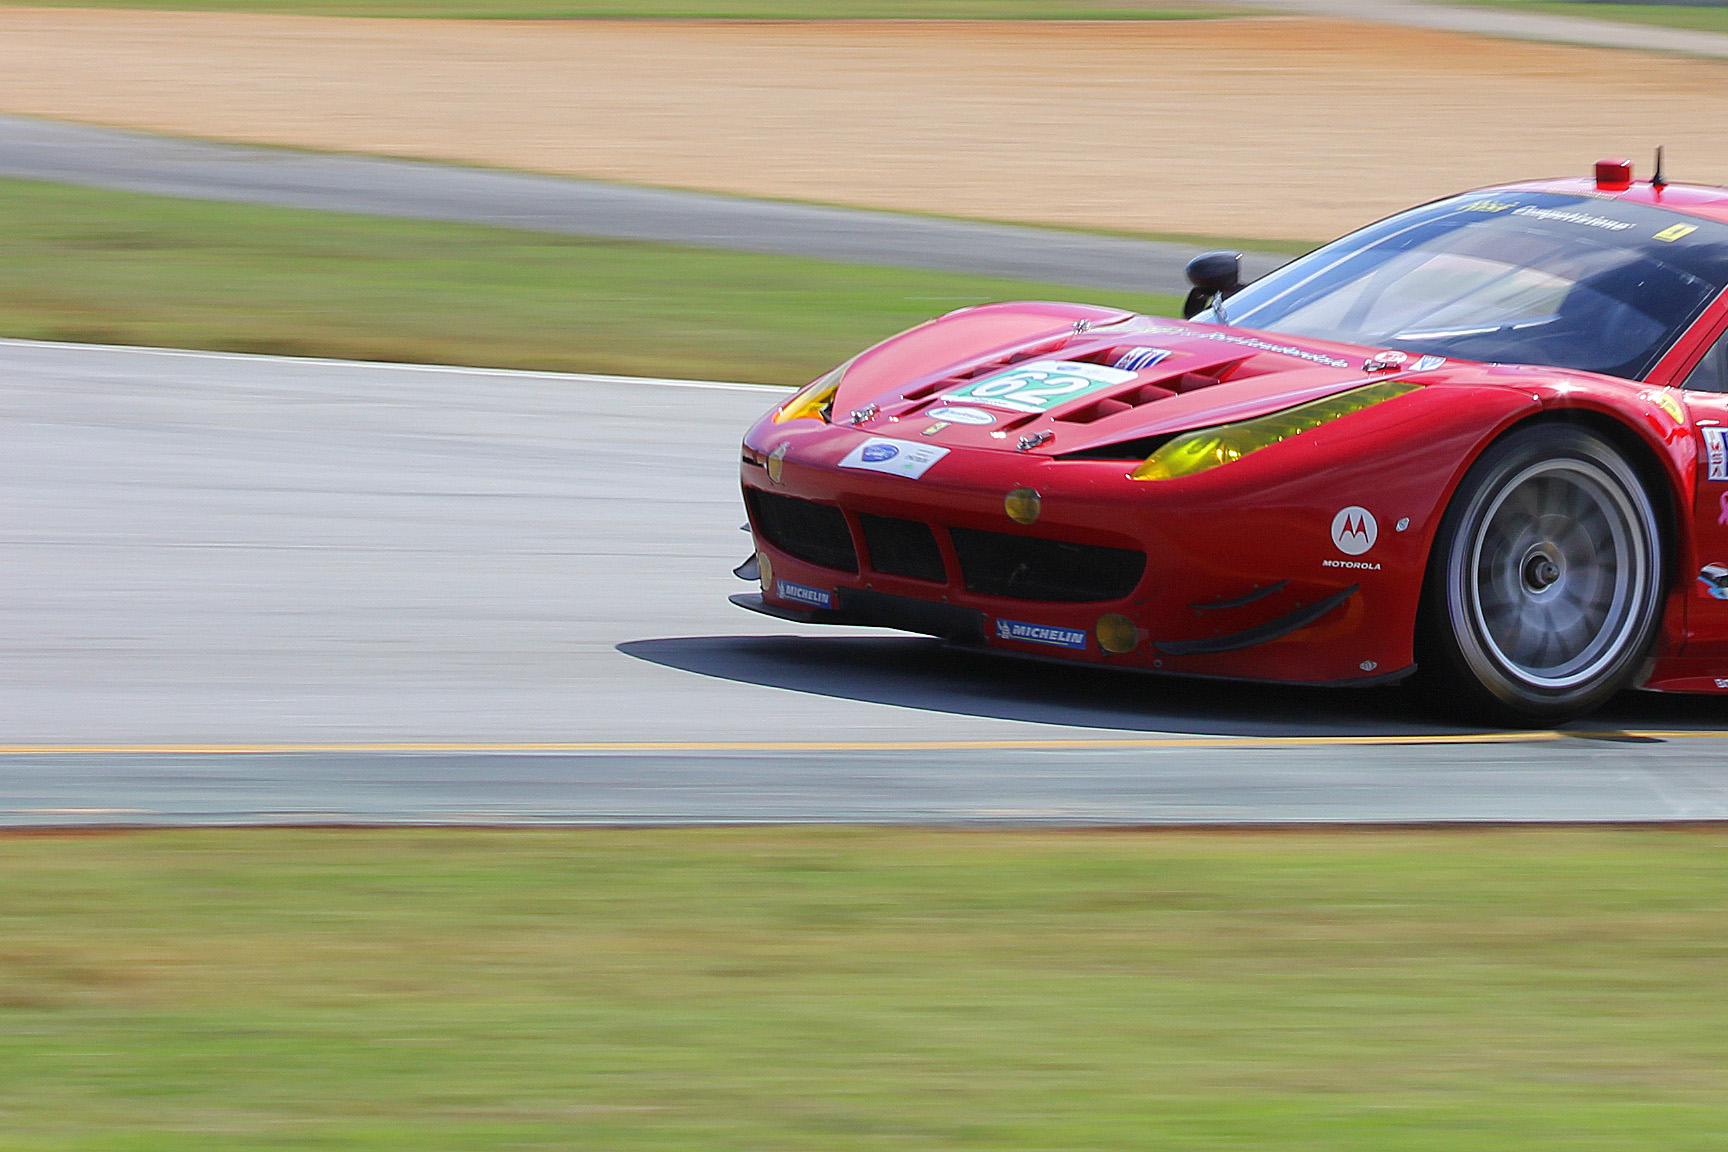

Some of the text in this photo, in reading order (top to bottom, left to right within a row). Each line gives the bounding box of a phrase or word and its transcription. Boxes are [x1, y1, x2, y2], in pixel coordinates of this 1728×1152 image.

[970, 370, 1091, 406] 62
[1322, 559, 1382, 570] MOTOROLA
[785, 584, 829, 604] MICHELIN
[1012, 623, 1084, 644] MICHELIN
